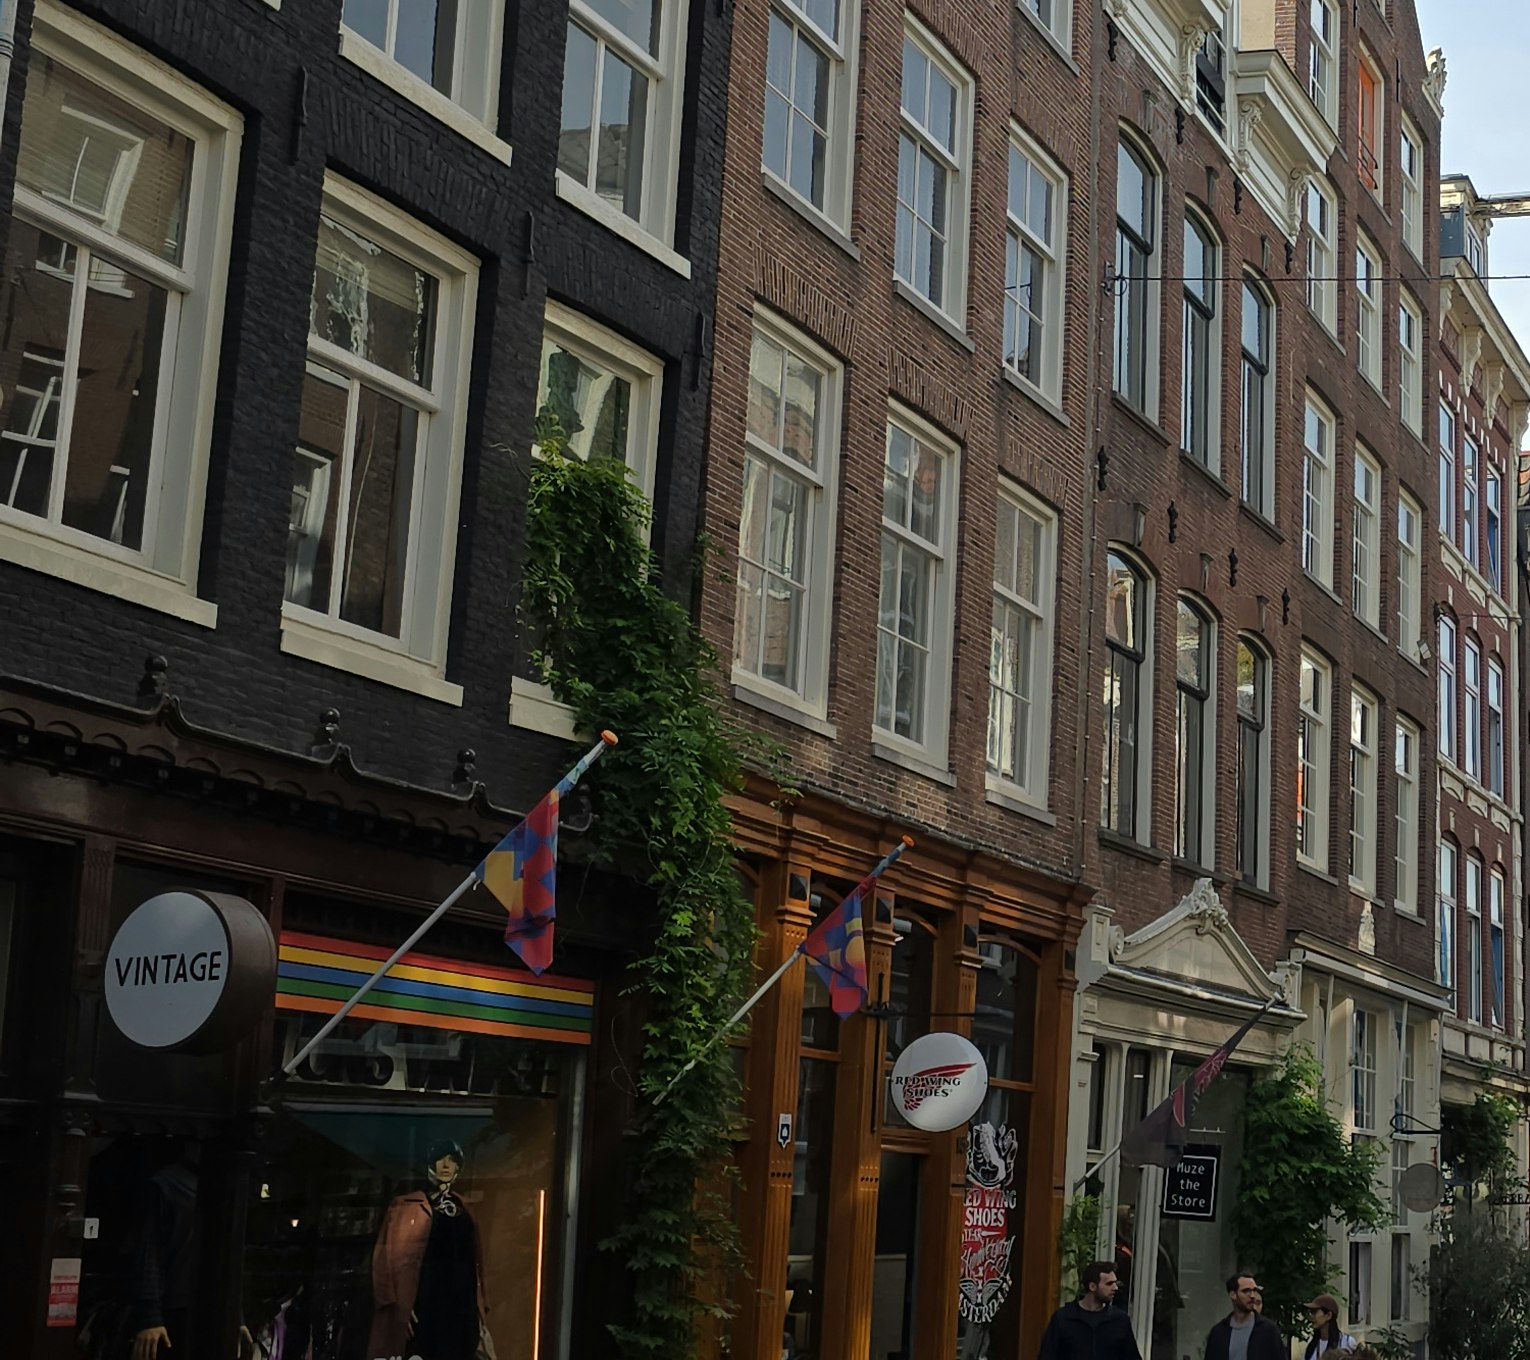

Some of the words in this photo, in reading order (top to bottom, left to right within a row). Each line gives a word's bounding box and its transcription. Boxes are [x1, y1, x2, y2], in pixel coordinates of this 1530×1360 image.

[115, 951, 222, 987] VINTAGE
[895, 1076, 921, 1086] RED
[924, 1076, 961, 1087] WING
[906, 1088, 949, 1098] SHOES
[1176, 1161, 1206, 1175] Muze
[1180, 1178, 1201, 1191] the
[983, 1189, 1017, 1210] WING
[1170, 1193, 1207, 1208] Store
[965, 1206, 1006, 1227] SHOES
